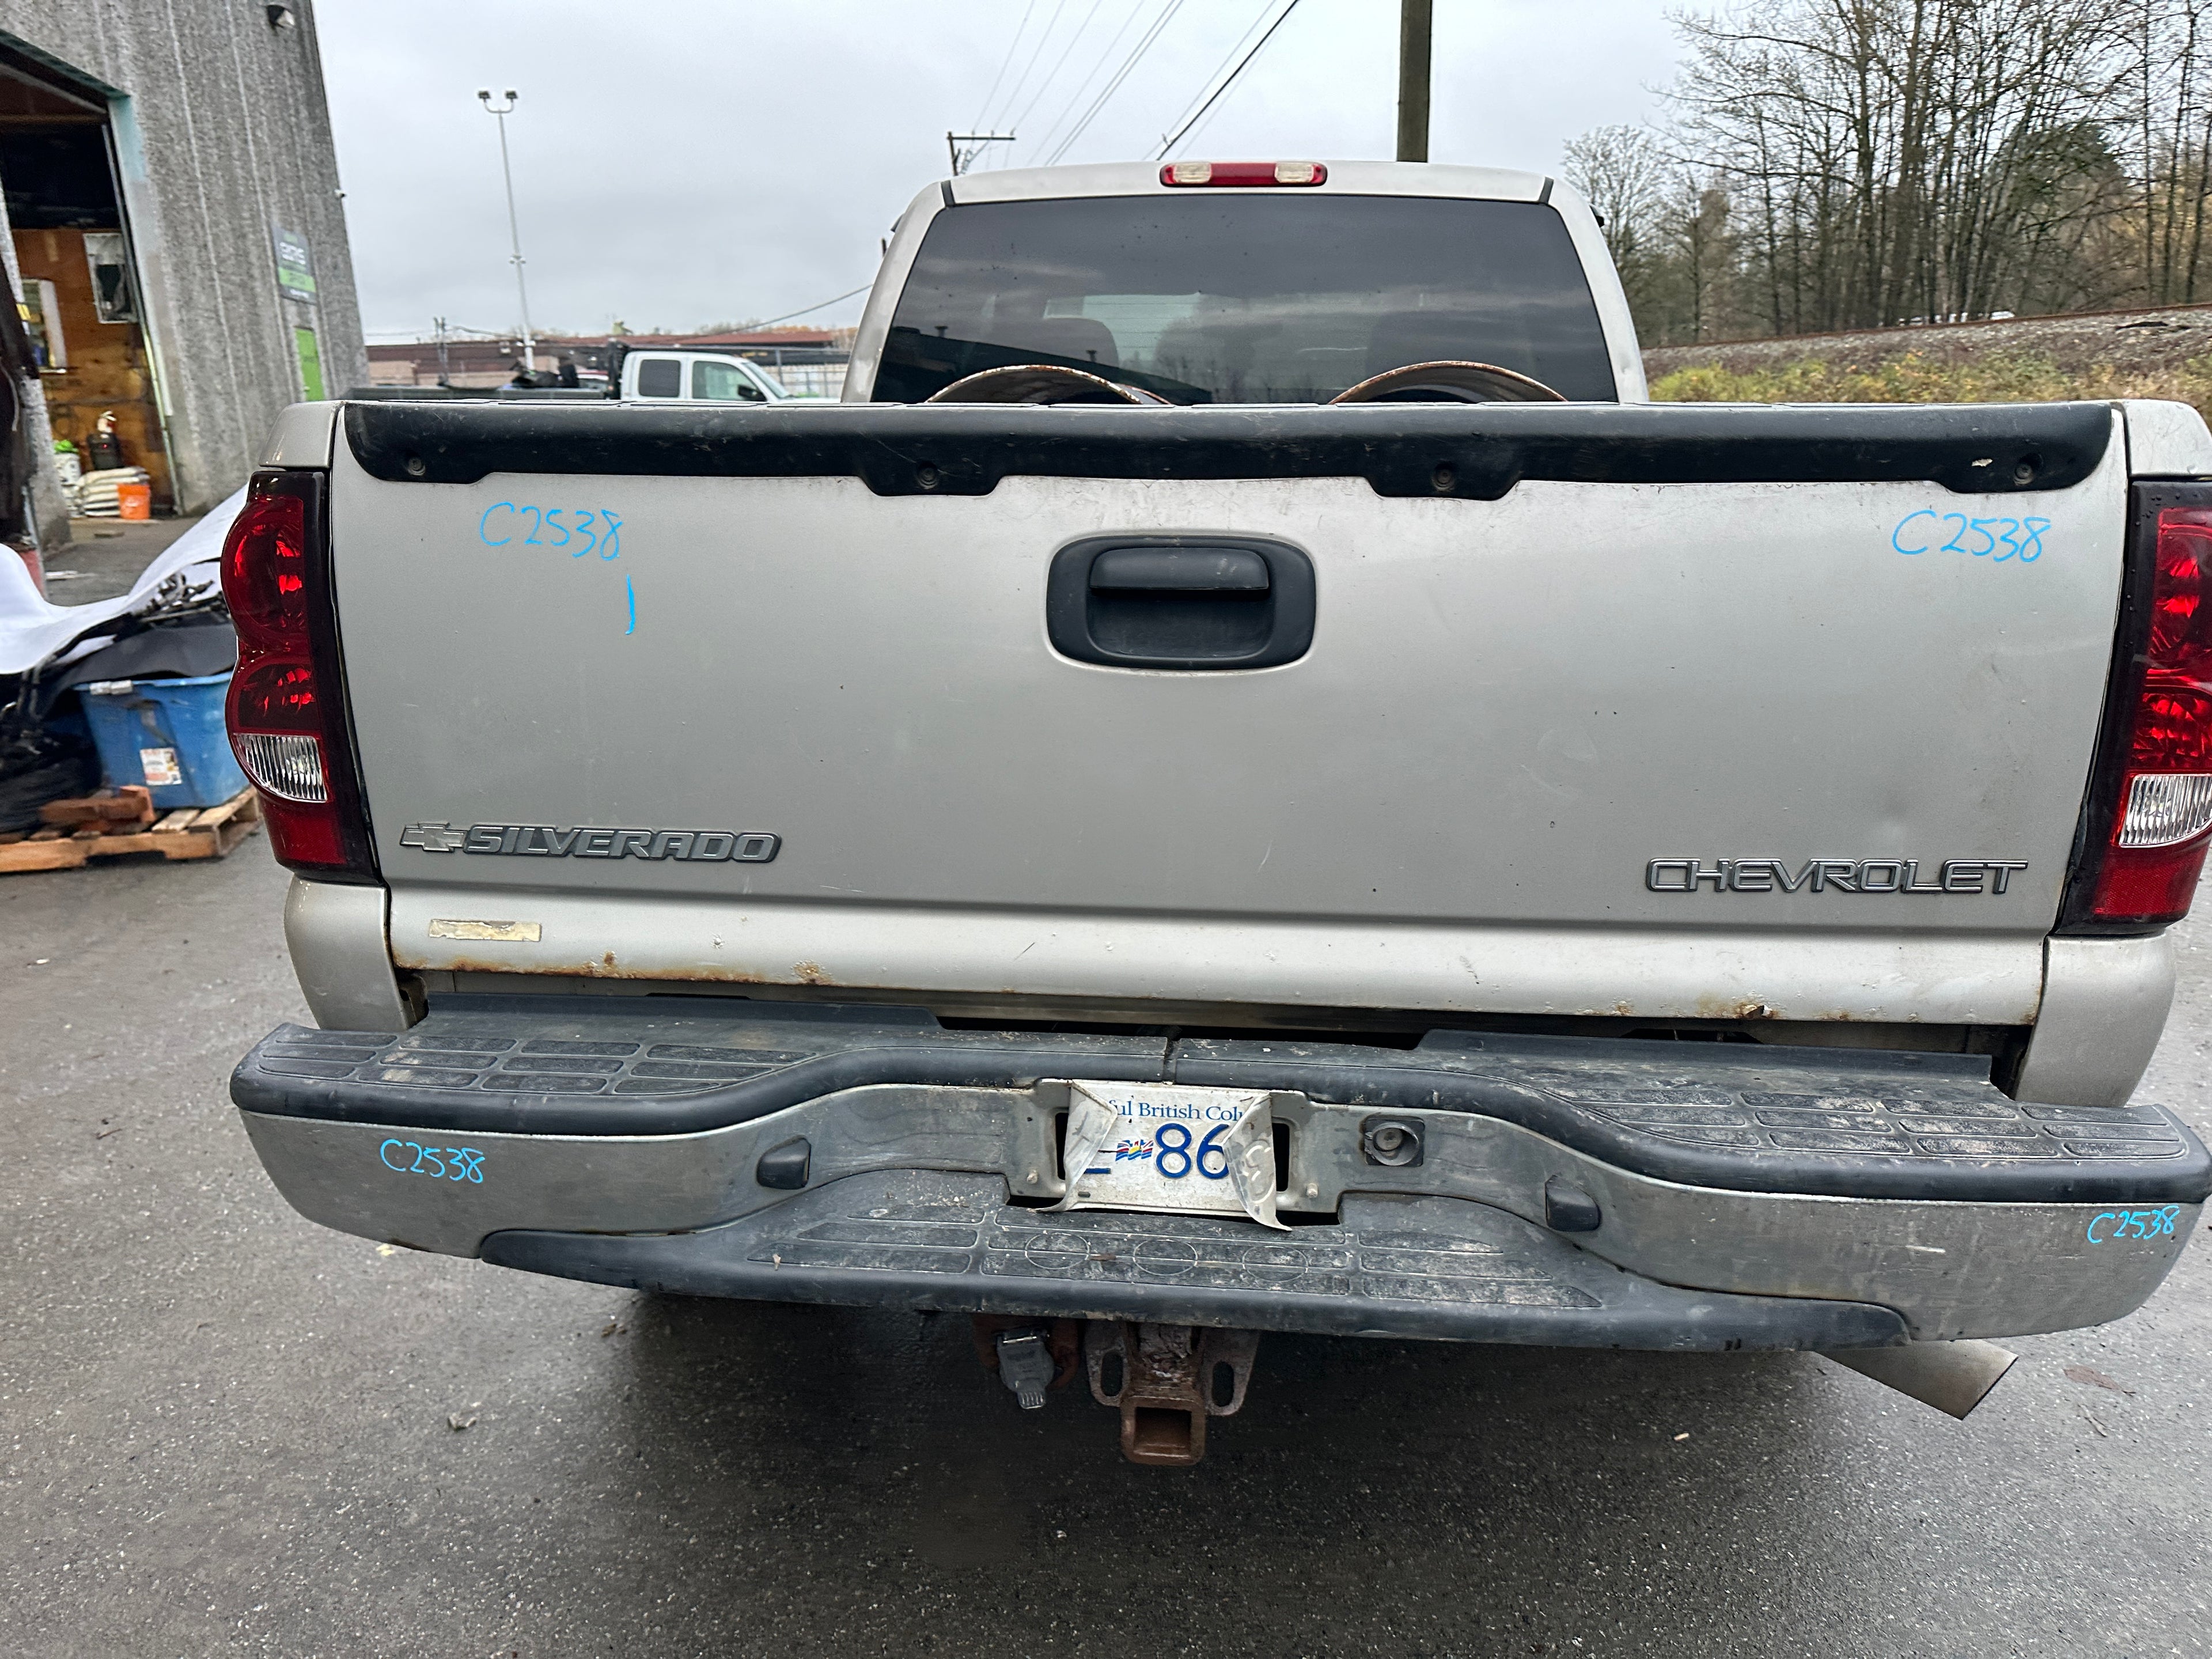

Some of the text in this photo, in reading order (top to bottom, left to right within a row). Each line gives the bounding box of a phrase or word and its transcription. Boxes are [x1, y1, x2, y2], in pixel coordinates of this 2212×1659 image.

[479, 501, 623, 561] C2538
[1891, 509, 2051, 563] C2538
[464, 824, 781, 863] SILVERADO
[1647, 858, 2028, 893] CHEVROLET
[1138, 1103, 1200, 1119] British
[1206, 1106, 1243, 1121] Col
[380, 1138, 486, 1184] C2538
[2086, 1205, 2180, 1244] C2538
